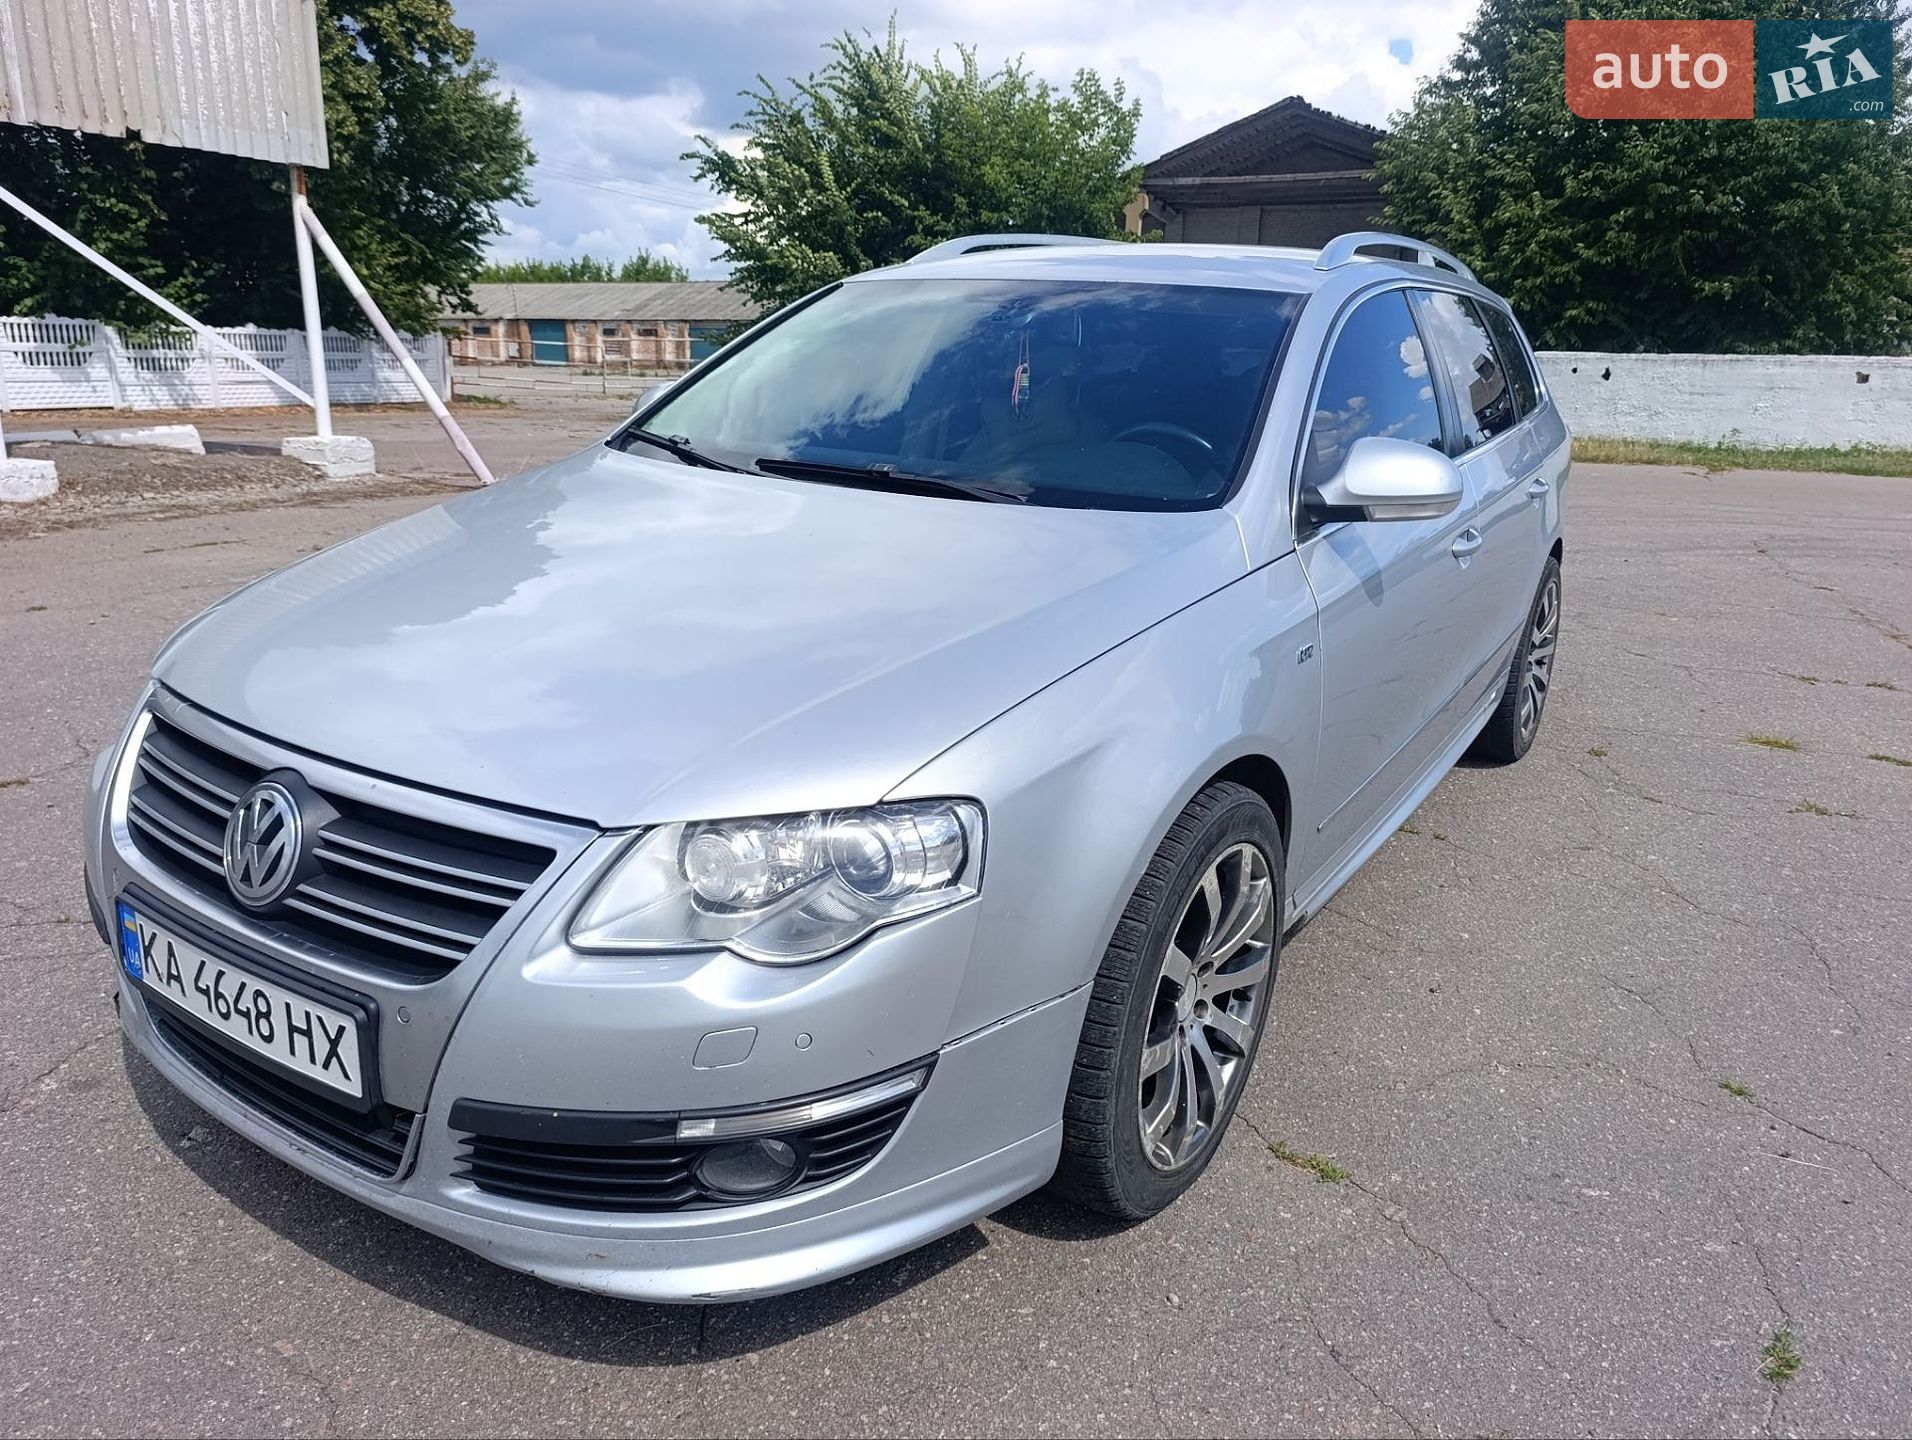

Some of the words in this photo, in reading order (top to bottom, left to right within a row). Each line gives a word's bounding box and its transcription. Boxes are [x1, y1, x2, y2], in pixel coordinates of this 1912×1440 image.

[138, 922, 187, 998] KA
[194, 959, 275, 1044] 4648
[285, 1001, 352, 1082] HX
